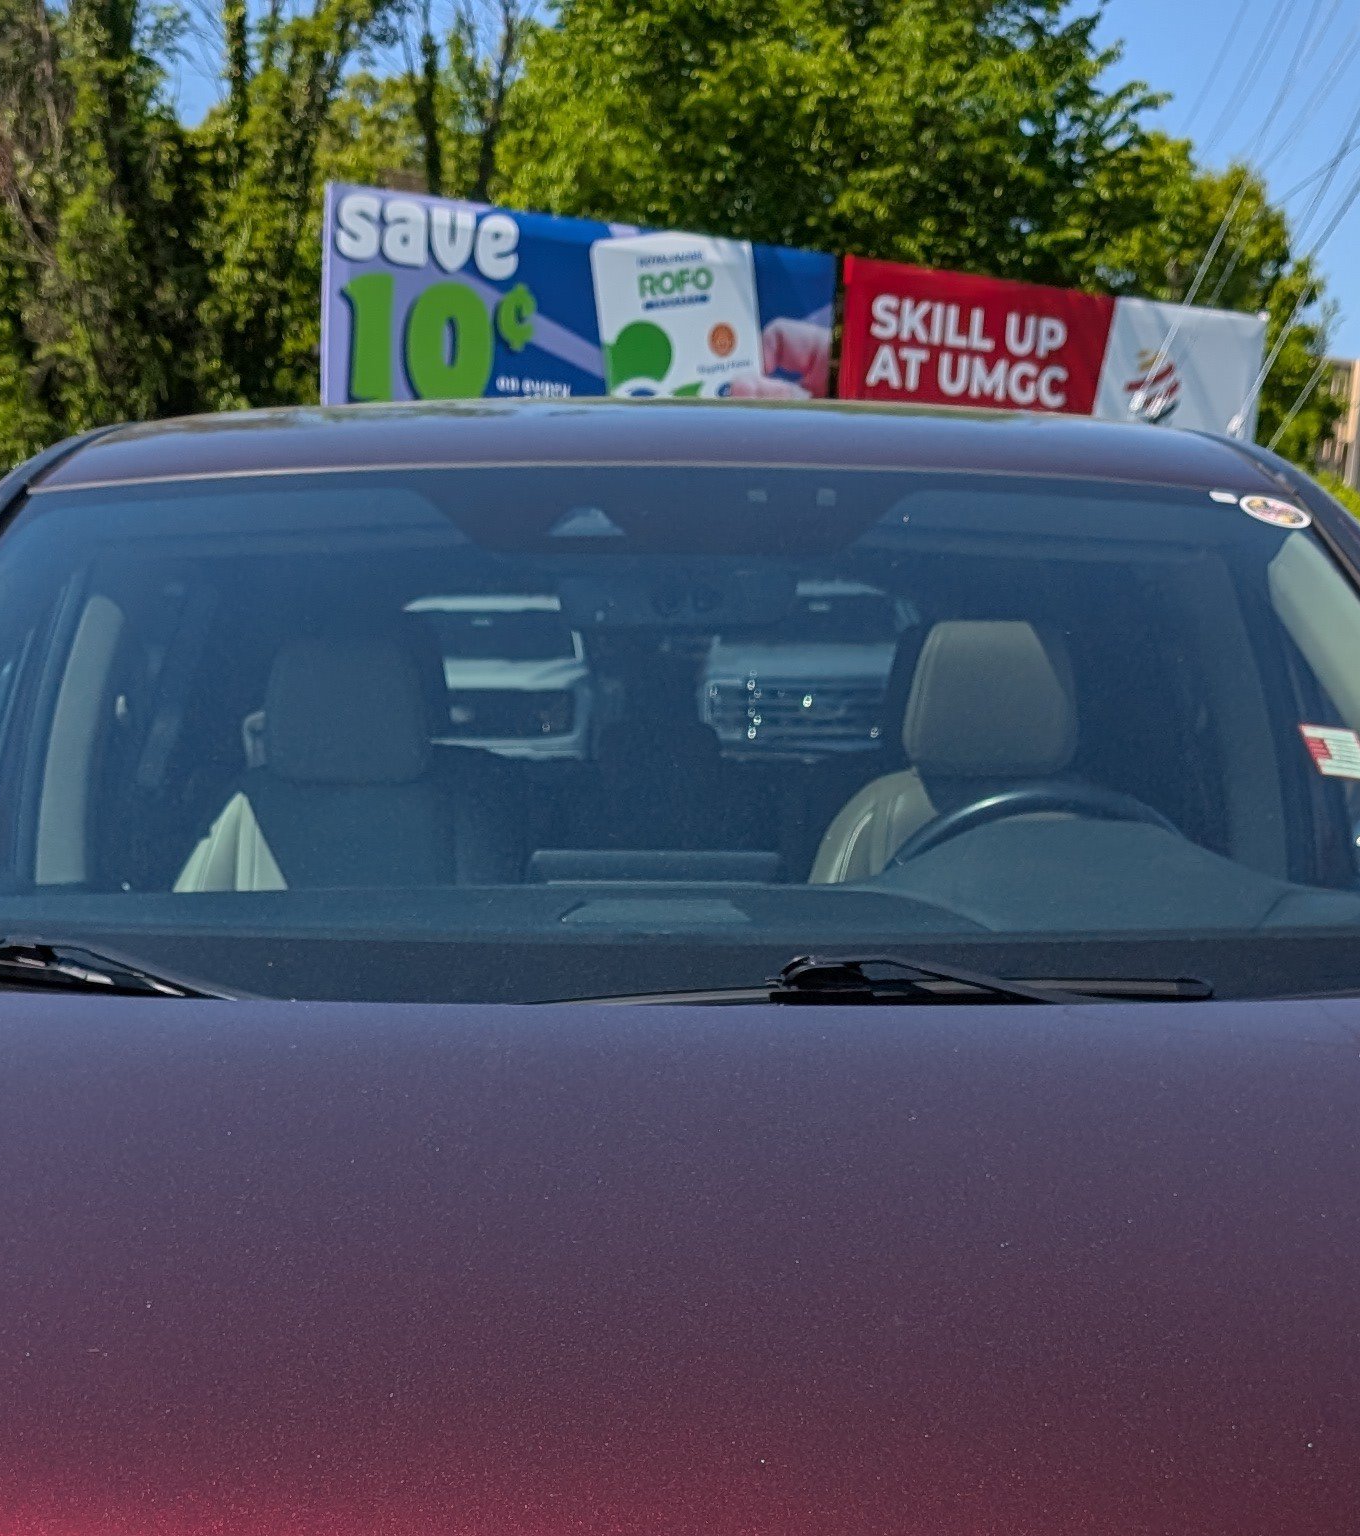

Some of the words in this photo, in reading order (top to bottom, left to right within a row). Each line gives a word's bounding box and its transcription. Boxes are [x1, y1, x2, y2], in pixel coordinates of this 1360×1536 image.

[638, 266, 714, 297] ROFO
[871, 294, 995, 353] SKILL
[1004, 312, 1067, 359] UP
[866, 344, 930, 391] AT
[939, 354, 1069, 409] UMGC
